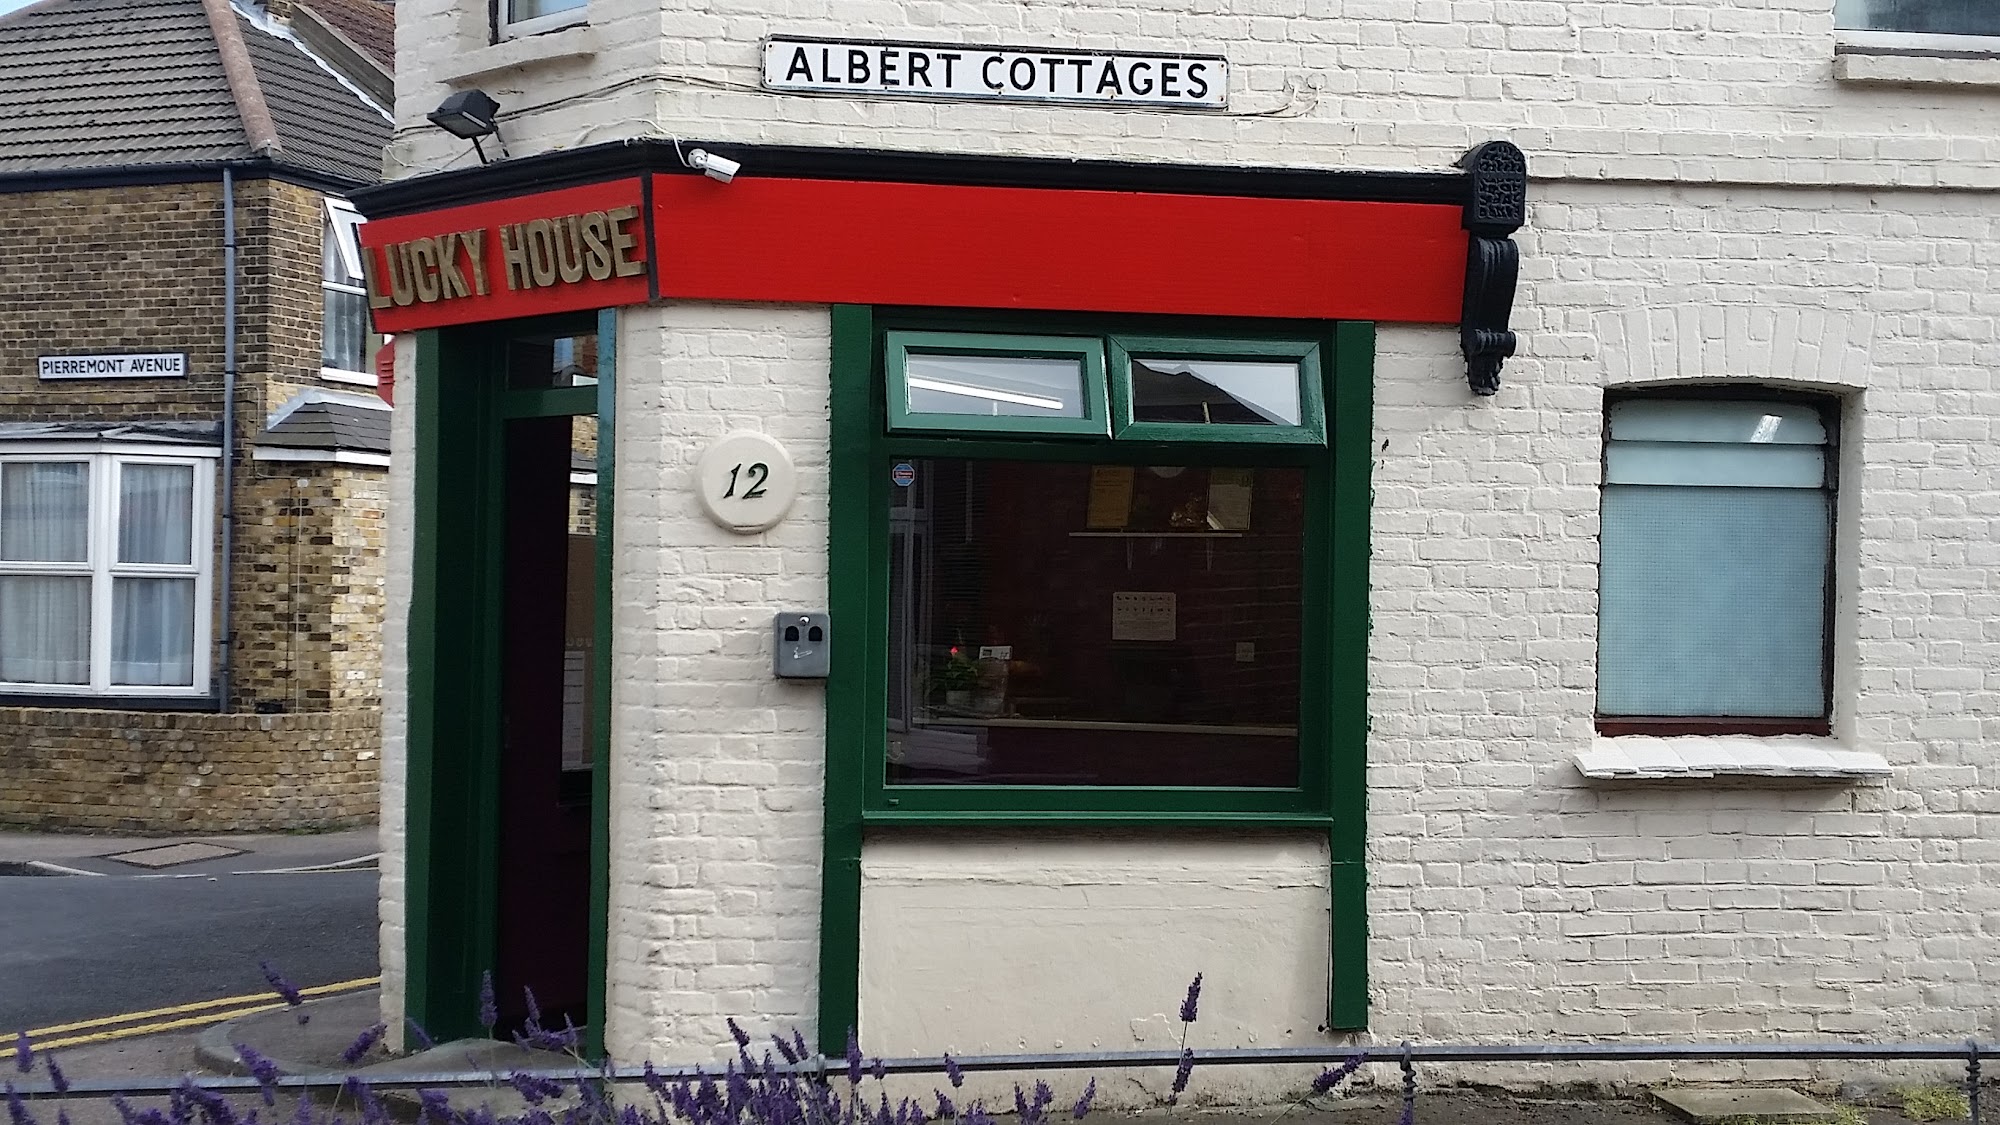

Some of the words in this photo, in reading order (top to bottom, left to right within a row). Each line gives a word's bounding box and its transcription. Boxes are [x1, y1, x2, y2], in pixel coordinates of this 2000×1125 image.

[785, 46, 961, 88] ALBERT
[982, 56, 1208, 98] COTTAGES
[363, 228, 491, 309] LUCKY
[499, 205, 647, 291] HOUSE
[42, 359, 125, 374] PIERREMONT
[130, 358, 181, 372] AVENUE
[723, 462, 769, 499] 12
